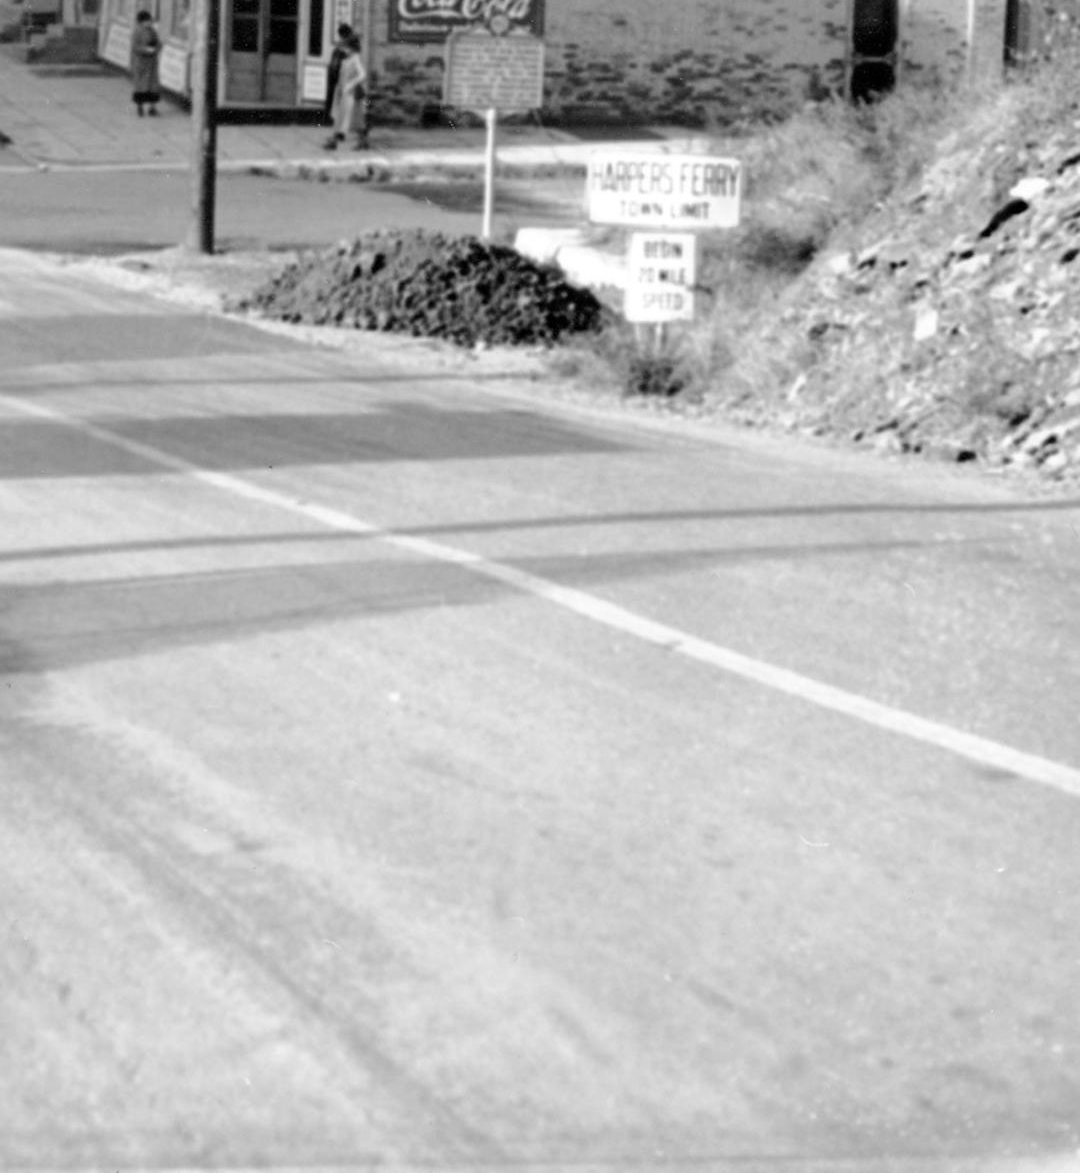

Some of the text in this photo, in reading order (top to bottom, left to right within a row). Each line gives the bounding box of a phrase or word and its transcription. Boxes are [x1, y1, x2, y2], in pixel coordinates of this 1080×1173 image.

[591, 161, 739, 197] HARPERS FERRY
[621, 200, 710, 220] TOWN LIMIT
